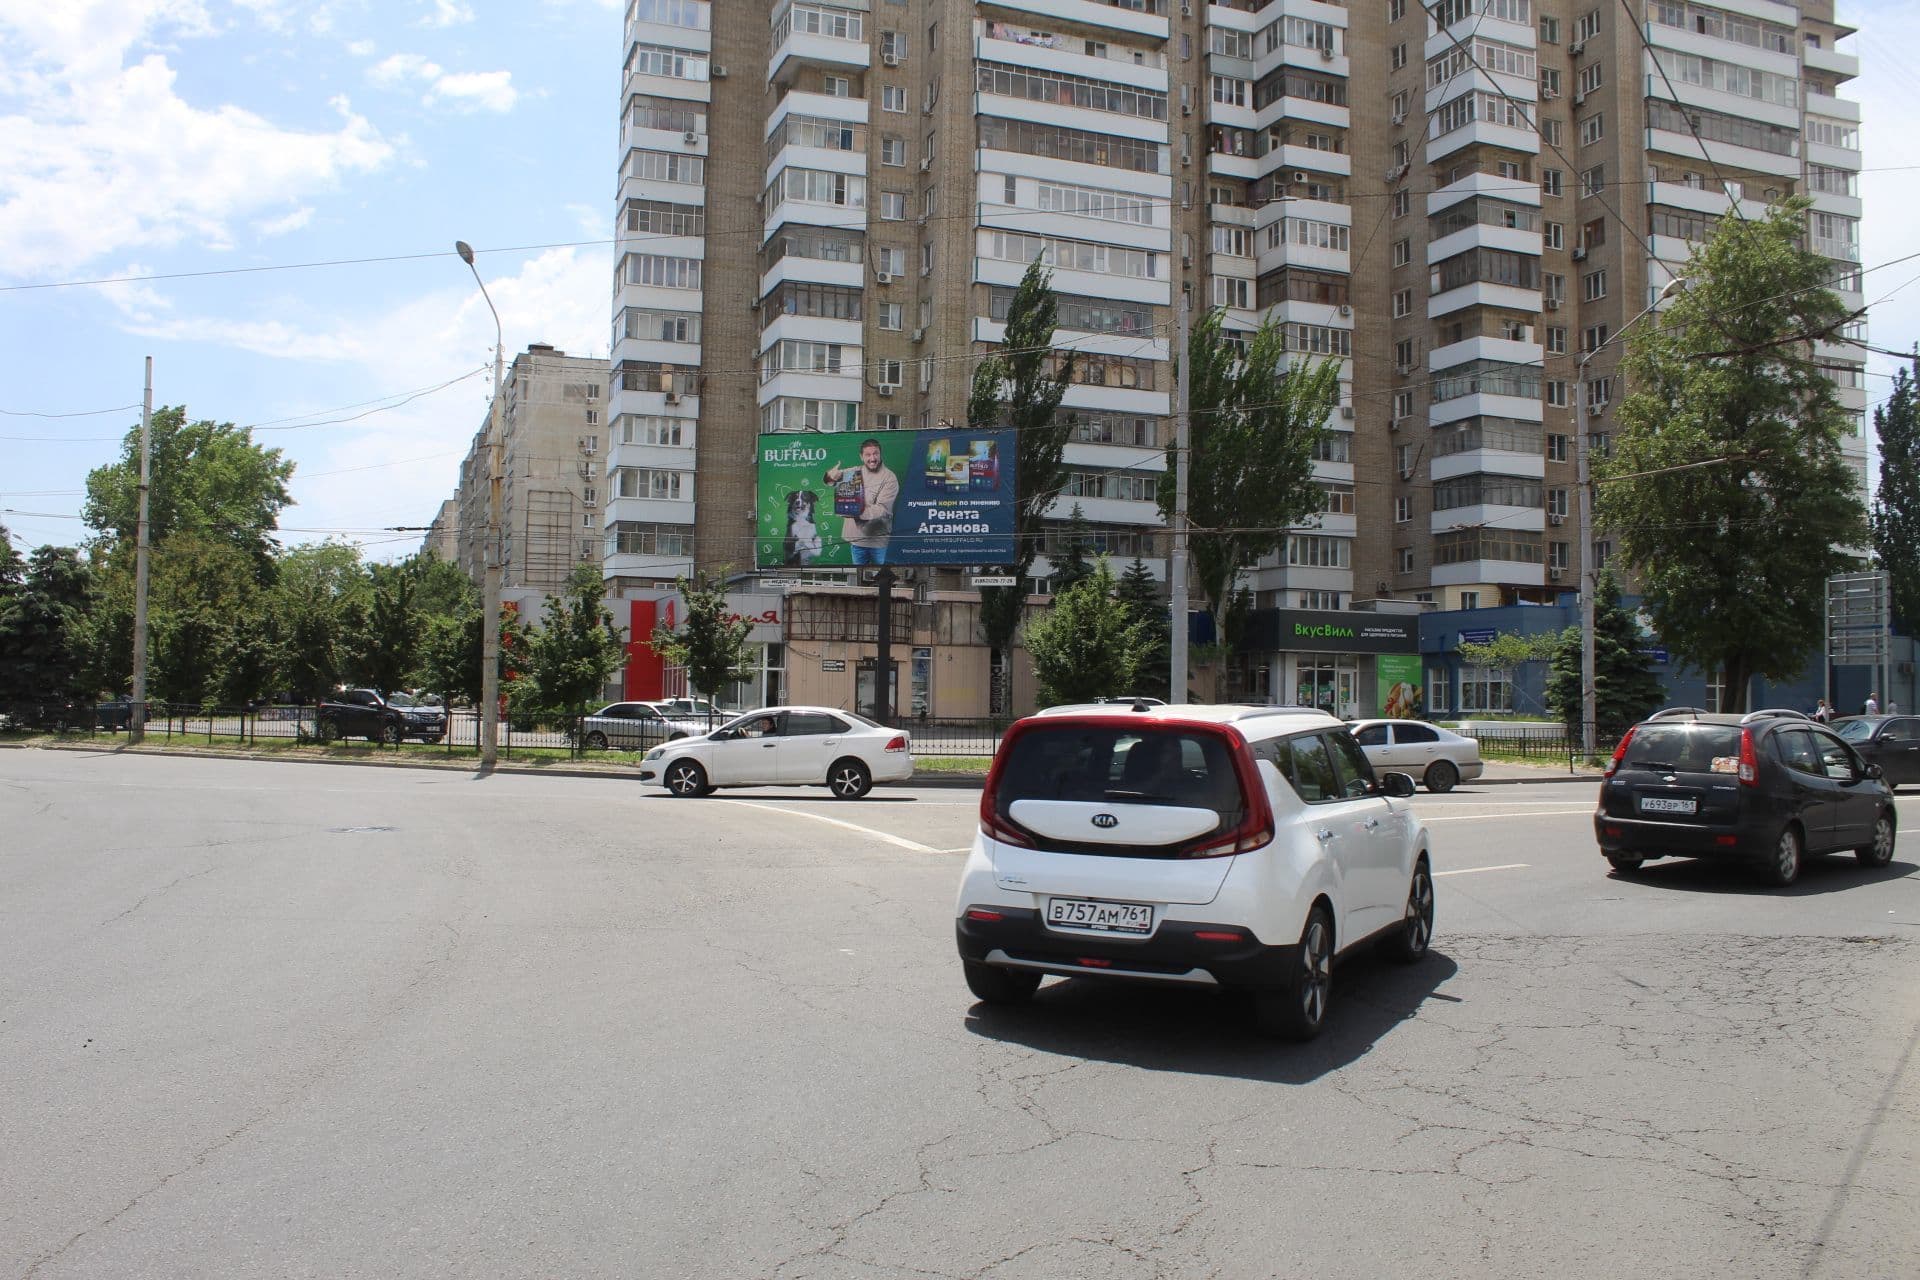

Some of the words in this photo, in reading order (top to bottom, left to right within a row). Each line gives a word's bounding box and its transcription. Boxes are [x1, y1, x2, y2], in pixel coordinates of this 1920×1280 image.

[764, 448, 827, 461] BUFFALO
[908, 499, 937, 508] лучший
[928, 508, 980, 520] Рената
[918, 522, 990, 534] Агзамова
[1295, 623, 1354, 638] ВкусВилл
[1095, 816, 1114, 825] KIA
